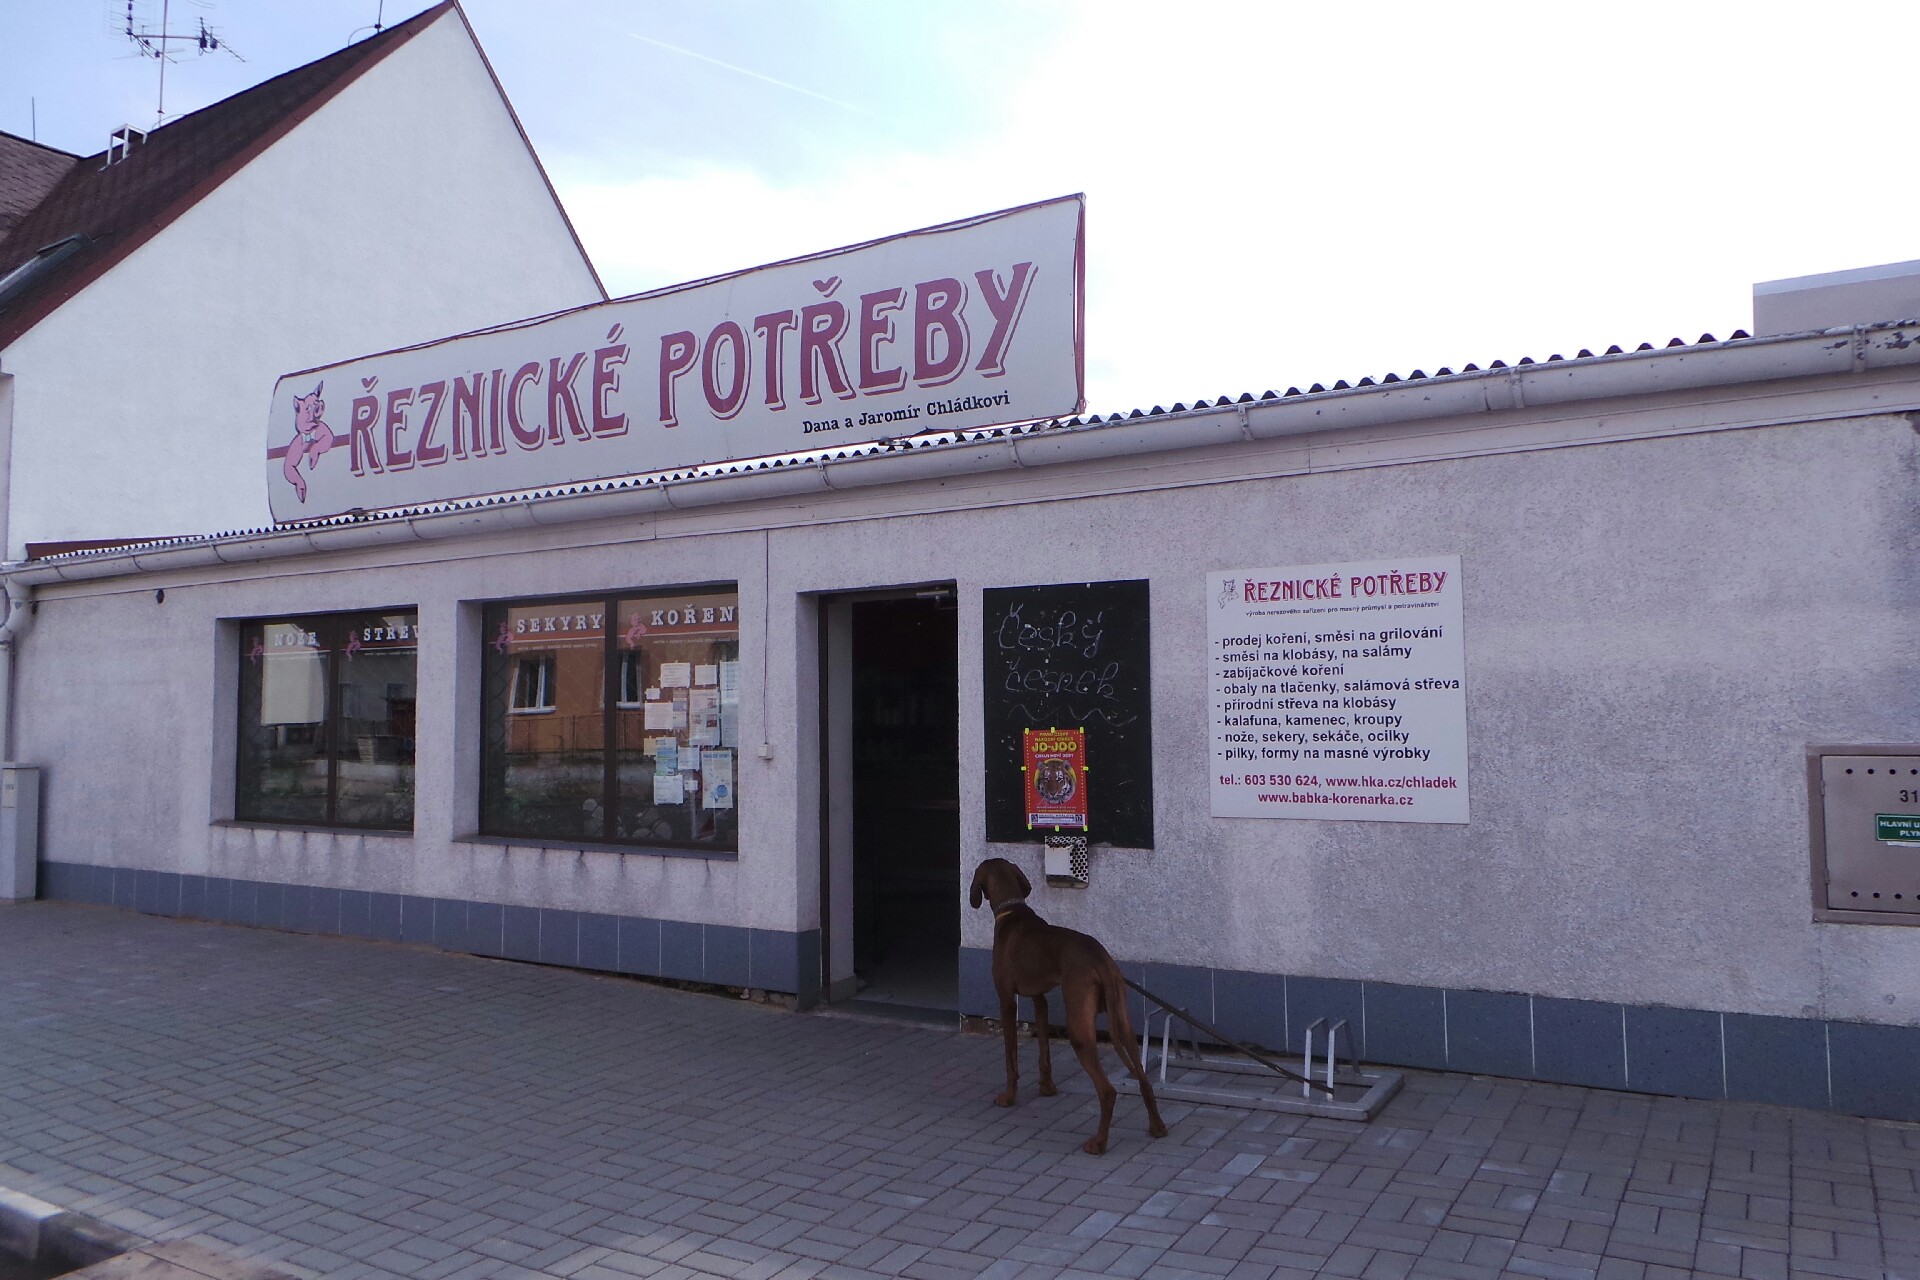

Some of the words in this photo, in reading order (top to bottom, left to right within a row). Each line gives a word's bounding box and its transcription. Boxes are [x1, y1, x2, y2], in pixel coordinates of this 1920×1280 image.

[350, 323, 630, 477] ŘEZNICKÉ
[659, 262, 1039, 428] POTŘEBY
[803, 419, 840, 434] Dana
[845, 417, 853, 428] a
[859, 404, 921, 426] Jaromír
[927, 390, 1010, 416] Chládkovi
[1244, 572, 1342, 603] ŘEZNICKÉ
[1351, 570, 1448, 598] POTŘEBY
[651, 603, 734, 626] KOŘEN
[1246, 609, 1265, 617] výroba
[1267, 608, 1301, 616] nerezového
[1339, 605, 1360, 613] masný
[1361, 604, 1387, 612] průmysl
[516, 614, 602, 633] SEKYRY
[1222, 634, 1262, 649] prodej
[1266, 631, 1311, 645] koření,
[1315, 630, 1354, 643] směsi
[1359, 631, 1375, 640] na
[1380, 625, 1443, 643] grilování
[1222, 650, 1259, 662] směsi
[1263, 651, 1278, 661] na
[1283, 648, 1338, 661] klobásy,
[1342, 648, 1358, 658] na
[1362, 644, 1412, 659] salámy
[1223, 665, 1298, 680] zabíjačkové
[1302, 663, 1344, 676] koření
[1223, 683, 1257, 696] obaly
[1261, 684, 1276, 694] na
[1281, 681, 1339, 695] tlačenky,
[1343, 678, 1410, 691] salámová
[1414, 677, 1460, 690] střeva
[1224, 698, 1273, 713] přírodní
[1277, 698, 1318, 709] střeva
[1322, 699, 1338, 709] na
[1343, 696, 1396, 710] klobásy
[1224, 715, 1281, 728] kalafuna,
[1285, 714, 1349, 727] kamenec,
[1354, 714, 1402, 728] kroupy
[1225, 731, 1258, 744] nože,
[1262, 731, 1308, 745] sekery,
[1312, 730, 1363, 743] sekáče,
[1367, 730, 1409, 744] ocilky
[1031, 741, 1077, 752] JO-JOO
[1225, 747, 1257, 760] pilky,
[1261, 747, 1299, 761] formy
[1304, 749, 1319, 759] na
[1324, 747, 1368, 759] masné
[1373, 747, 1430, 761] výrobky
[1220, 774, 1240, 785] tel.:
[1244, 774, 1266, 785] 603
[1269, 774, 1291, 786] 530
[1295, 775, 1322, 788] 624,
[1326, 775, 1457, 788] www.hka.cz/chladek
[1258, 792, 1413, 805] www.babka-korenarka.cz
